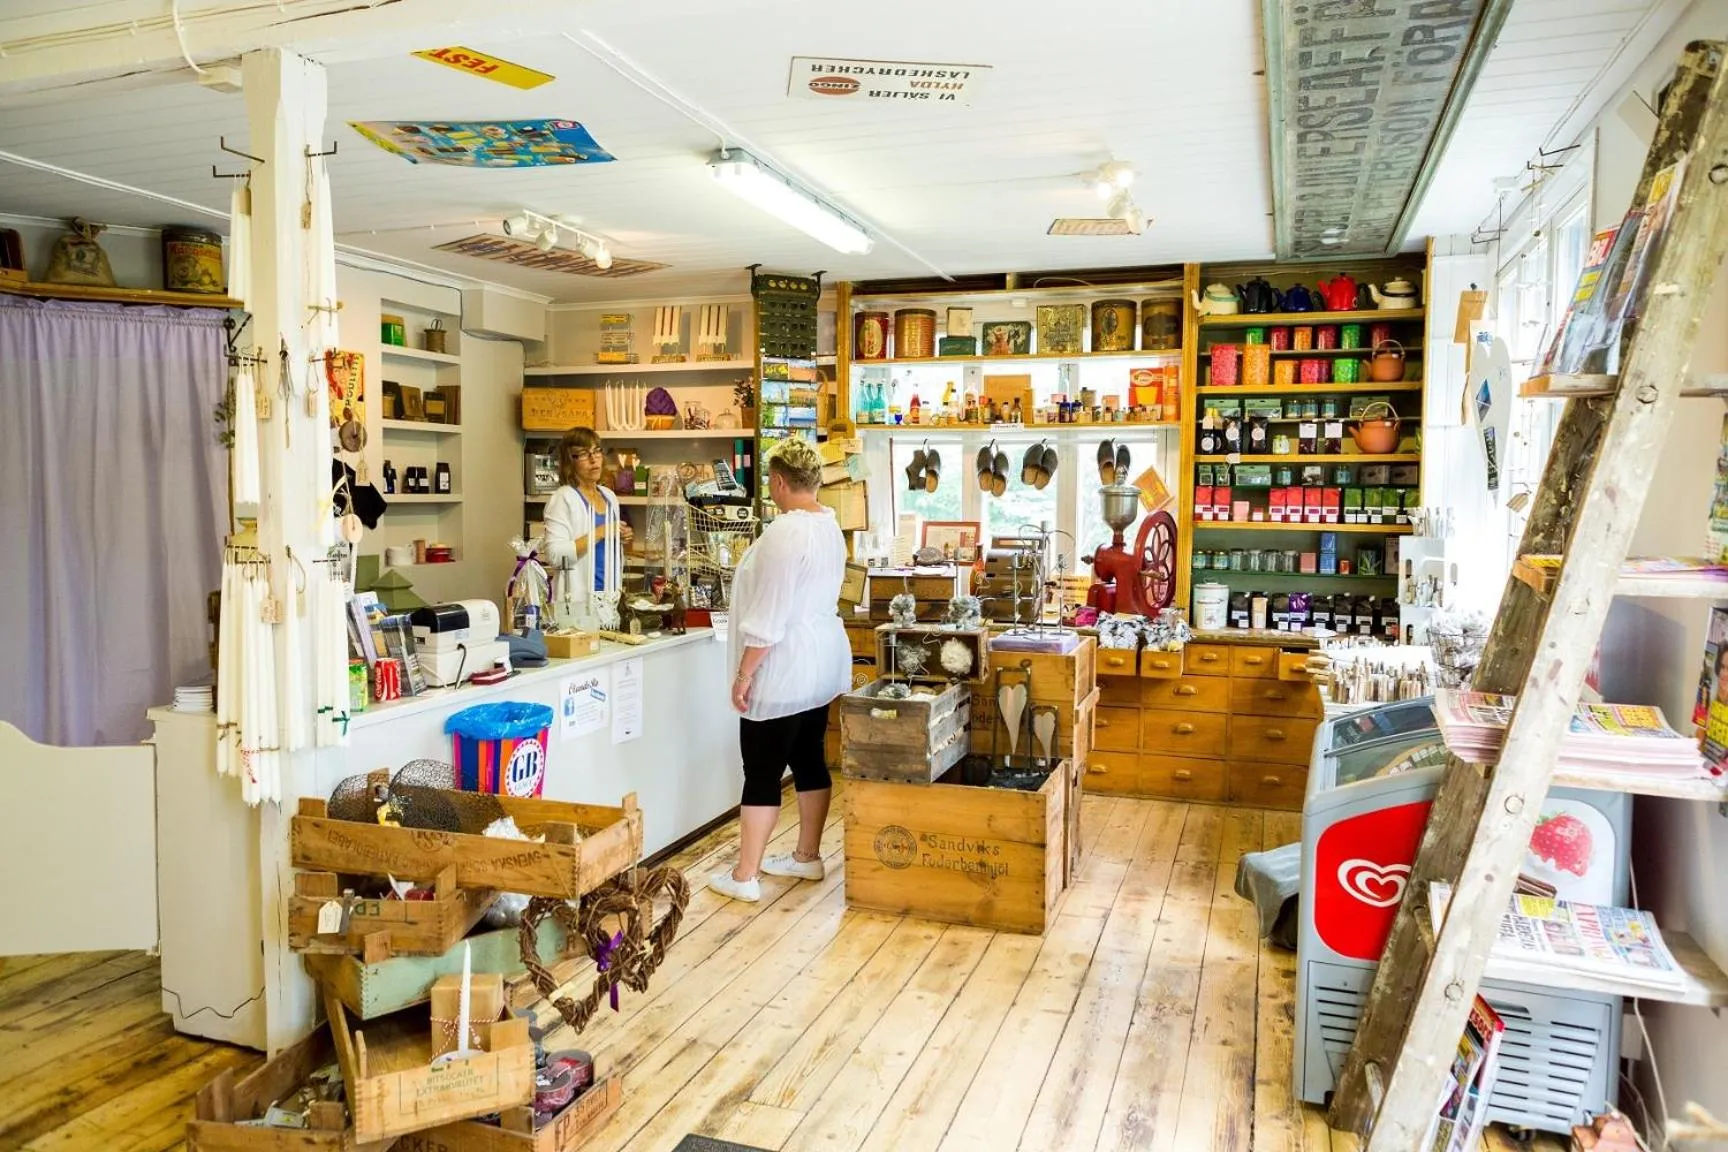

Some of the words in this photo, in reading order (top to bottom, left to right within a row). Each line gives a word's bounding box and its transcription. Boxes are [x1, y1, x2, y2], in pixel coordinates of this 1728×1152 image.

[428, 48, 500, 75] FEST
[940, 93, 956, 101] VI
[512, 751, 537, 783] GB
[927, 834, 1001, 856] Sandviks
